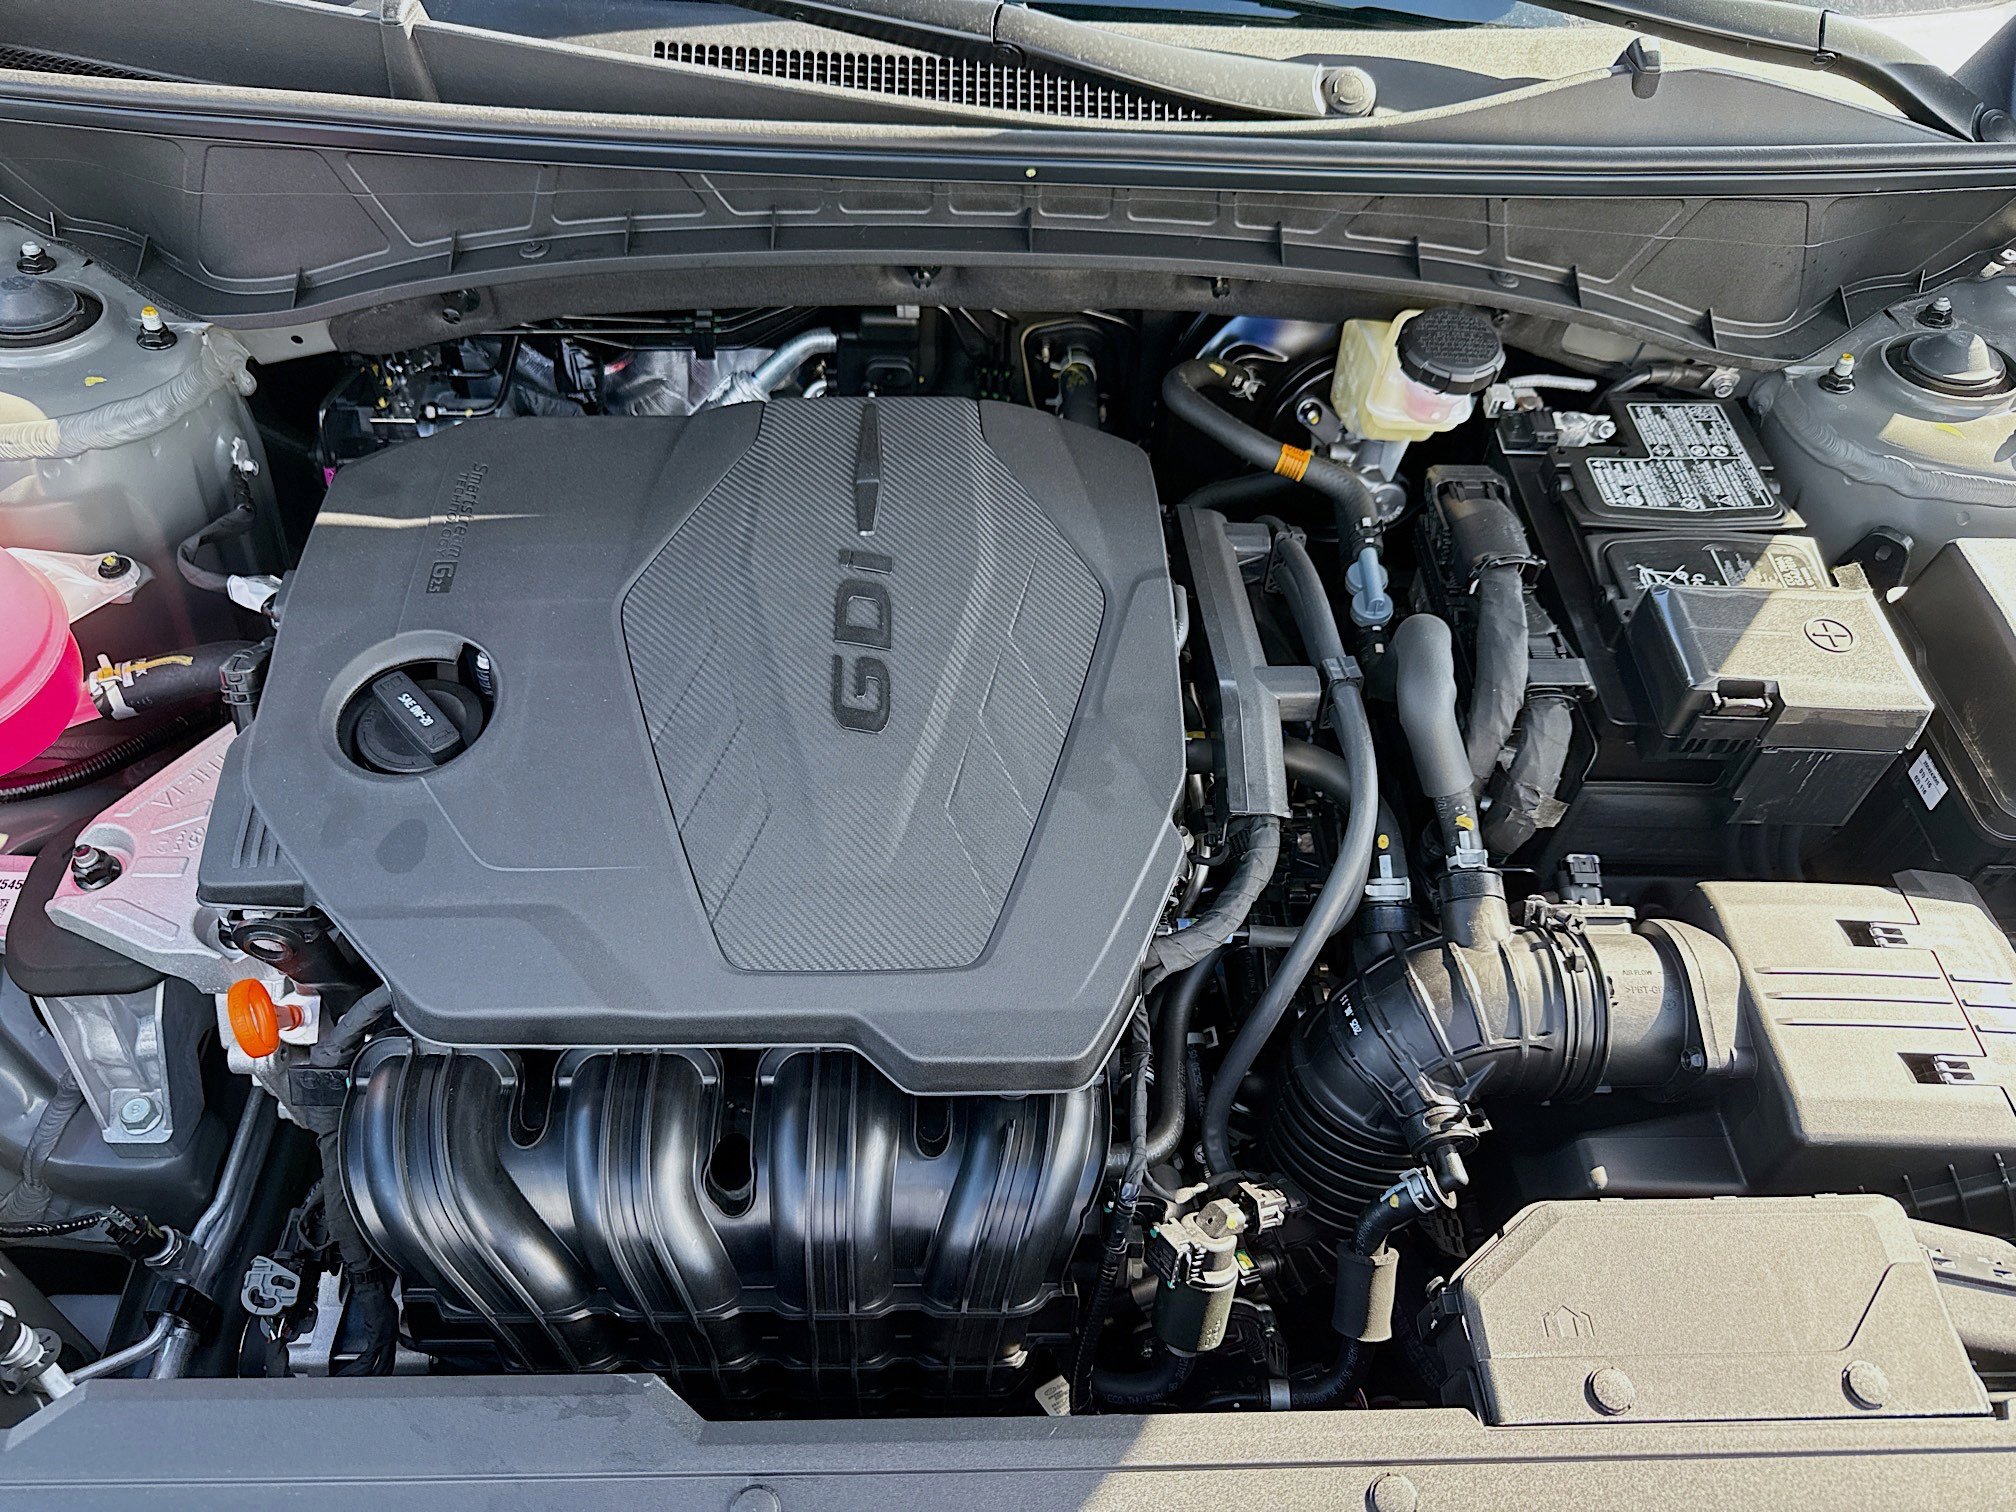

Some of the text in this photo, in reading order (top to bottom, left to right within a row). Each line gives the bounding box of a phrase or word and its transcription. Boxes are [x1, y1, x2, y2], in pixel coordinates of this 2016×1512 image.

[436, 472, 470, 558] TECHNOLOGY
[447, 463, 489, 558] Smartstream
[427, 563, 455, 593] G2.5
[397, 692, 435, 727] SAE 0W-20
[0, 878, 24, 890] 545
